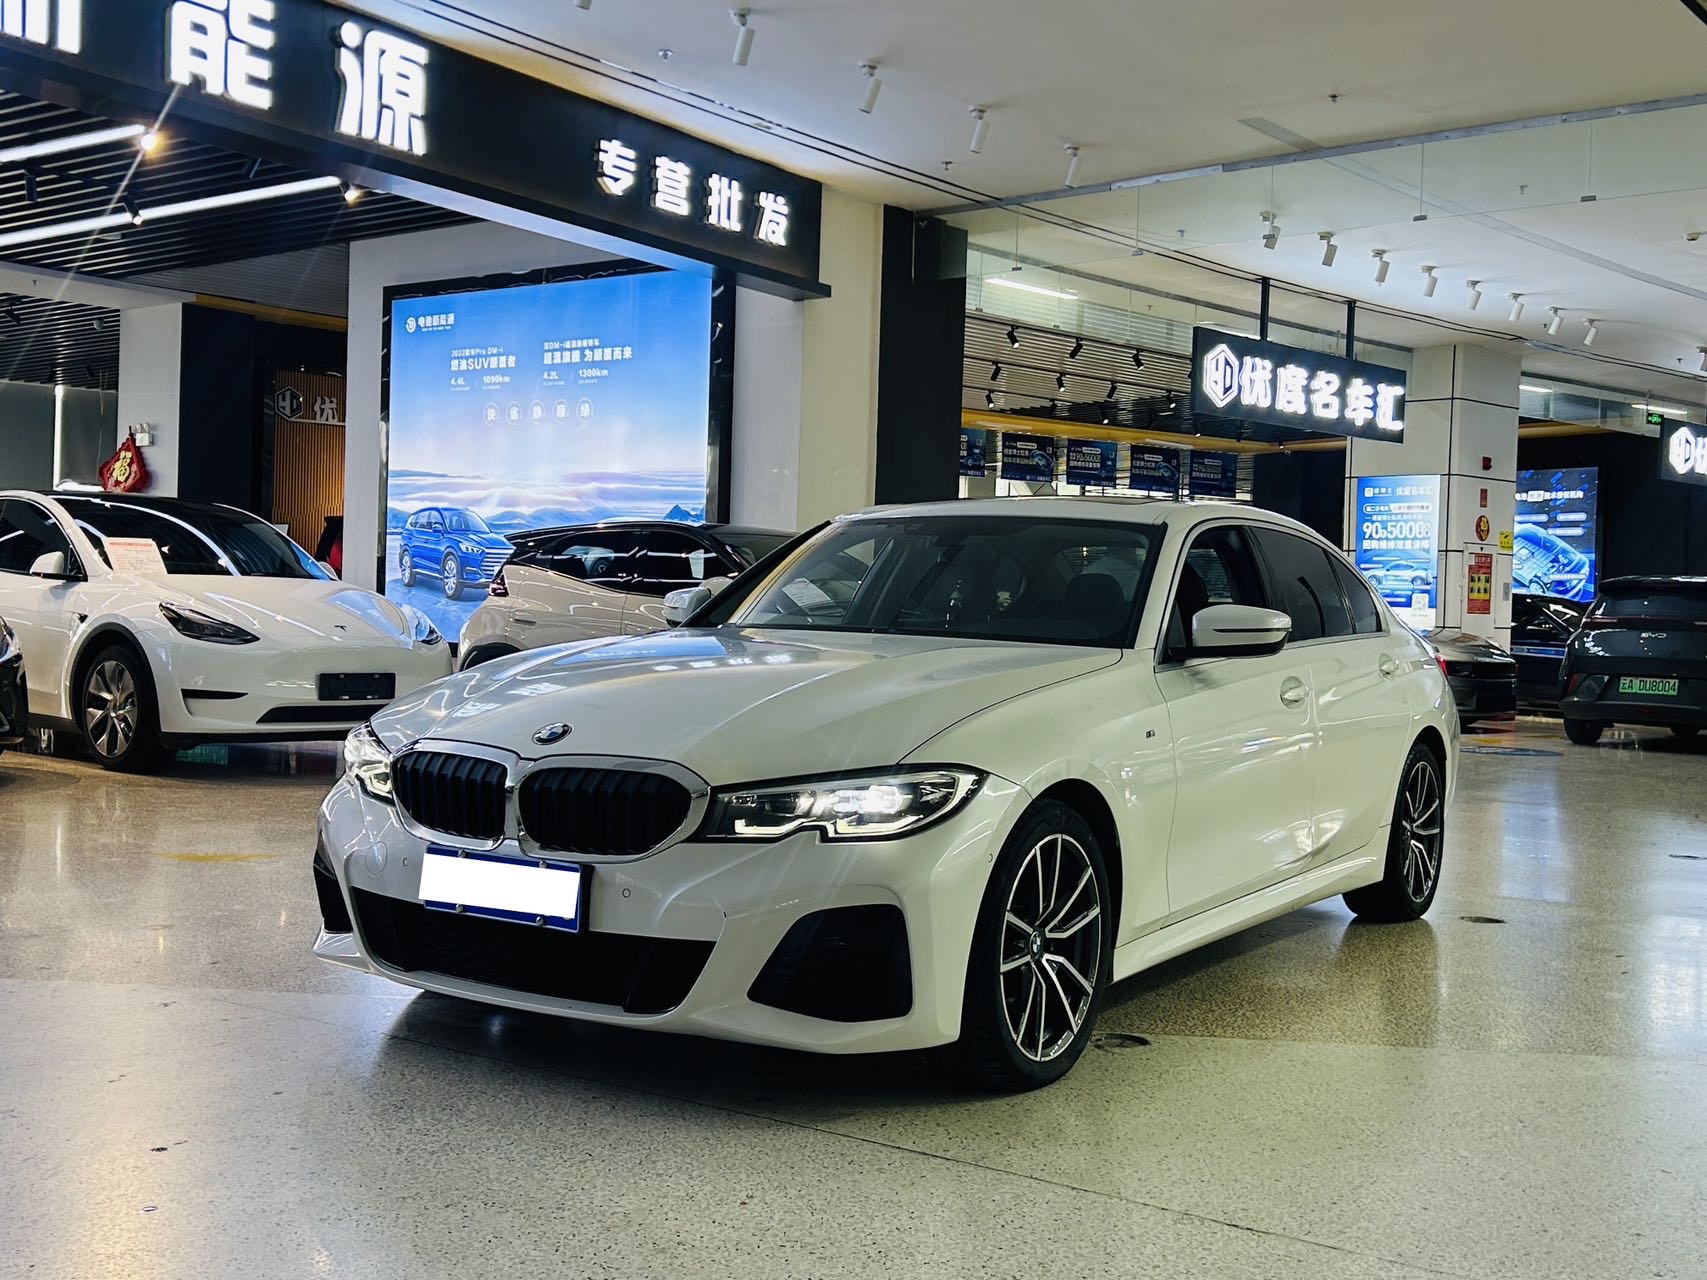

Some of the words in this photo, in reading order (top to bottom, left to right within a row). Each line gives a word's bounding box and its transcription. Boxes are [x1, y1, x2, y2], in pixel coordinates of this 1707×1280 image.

[597, 139, 790, 247] 专营批发
[482, 375, 510, 384] 1090km
[578, 368, 609, 378] 1300km
[1240, 355, 1405, 431] 优度名车汇
[112, 450, 133, 483] 福
[1639, 680, 1676, 692] DU8004
